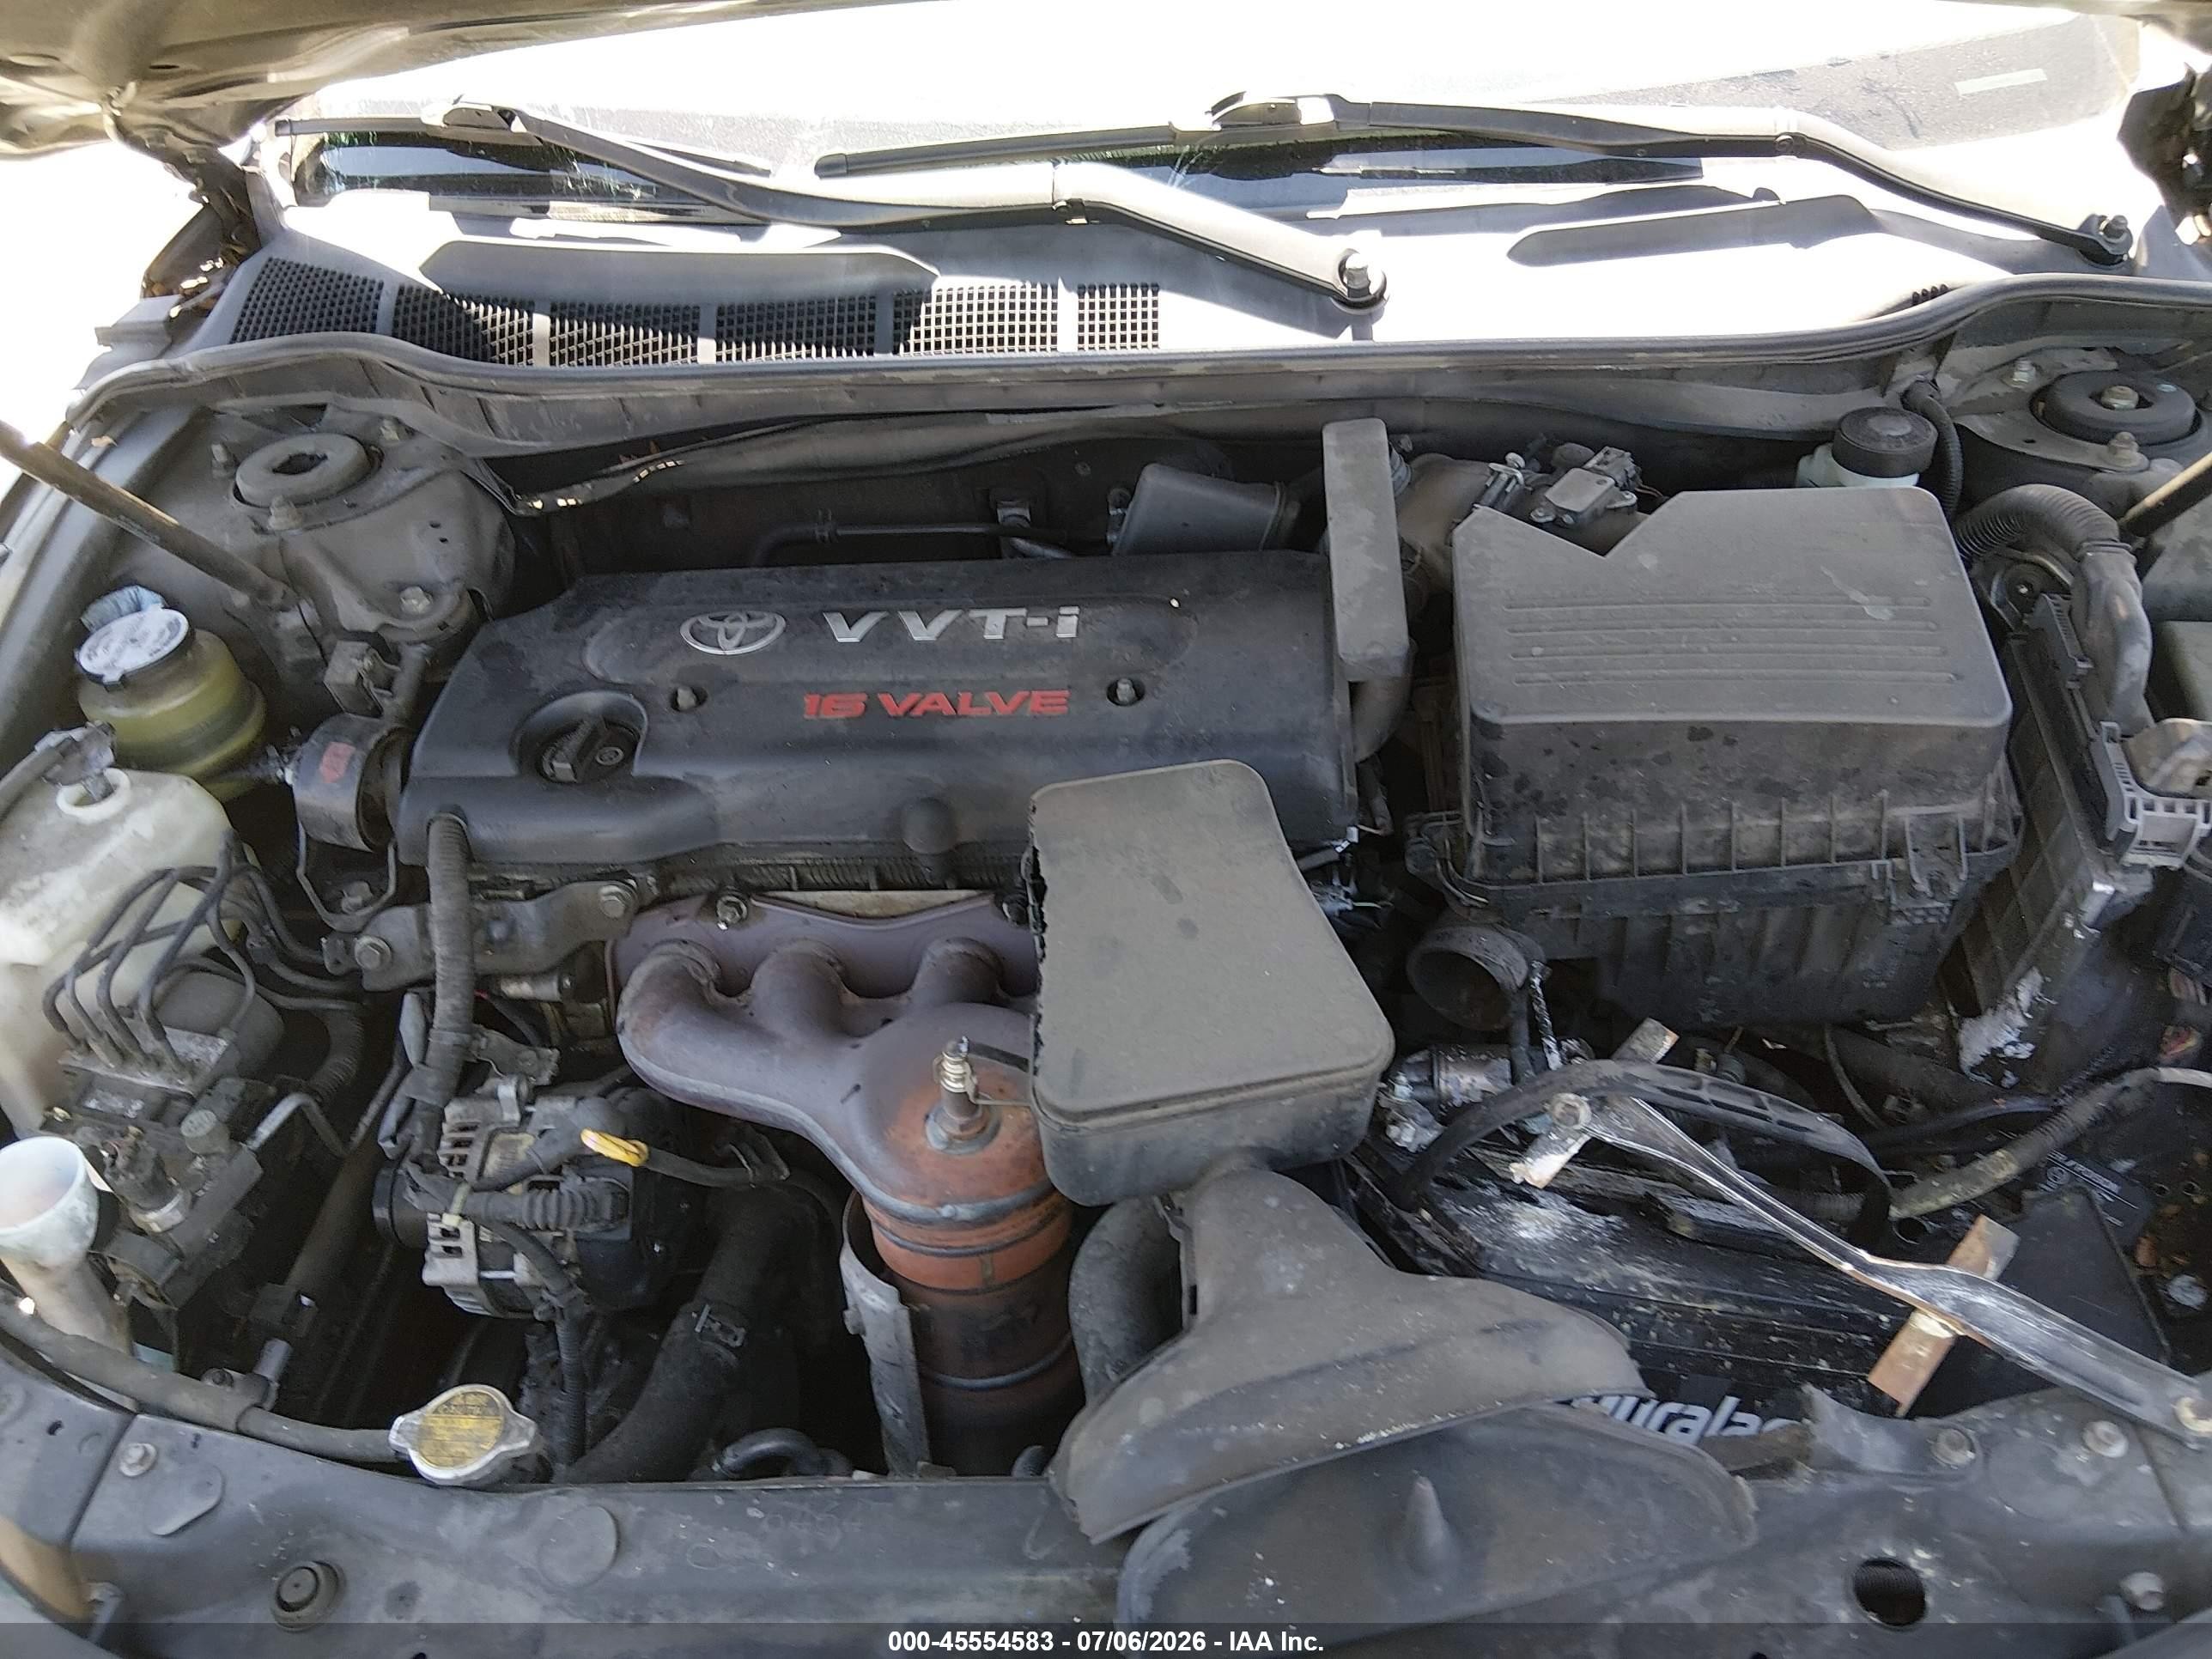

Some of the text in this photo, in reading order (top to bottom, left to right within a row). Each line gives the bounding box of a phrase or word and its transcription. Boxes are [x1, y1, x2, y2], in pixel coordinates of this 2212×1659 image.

[822, 605, 1080, 643] VVT-i
[803, 690, 1071, 719] 16 VALVE
[1573, 1394, 1802, 1446] urala
